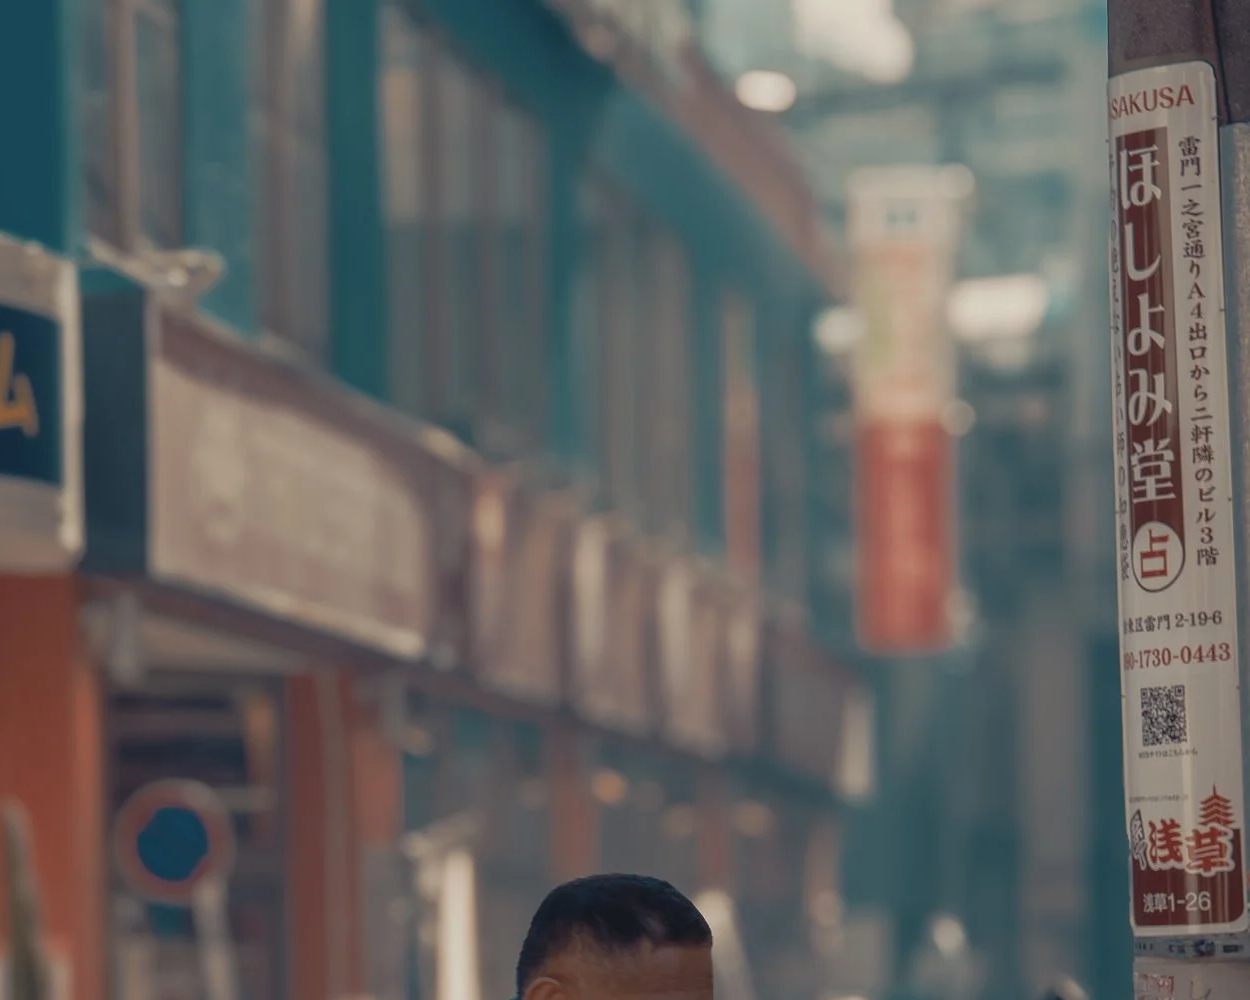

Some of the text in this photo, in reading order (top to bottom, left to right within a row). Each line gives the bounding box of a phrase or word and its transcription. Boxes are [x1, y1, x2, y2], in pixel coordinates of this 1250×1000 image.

[1108, 84, 1195, 120] SAKUSA
[1119, 144, 1177, 504] ほしよみ堂
[1140, 528, 1170, 579] 占
[1175, 610, 1222, 628] 2-19-6
[1148, 817, 1232, 873] 浅草
[1143, 891, 1211, 913] 浅草1-26
